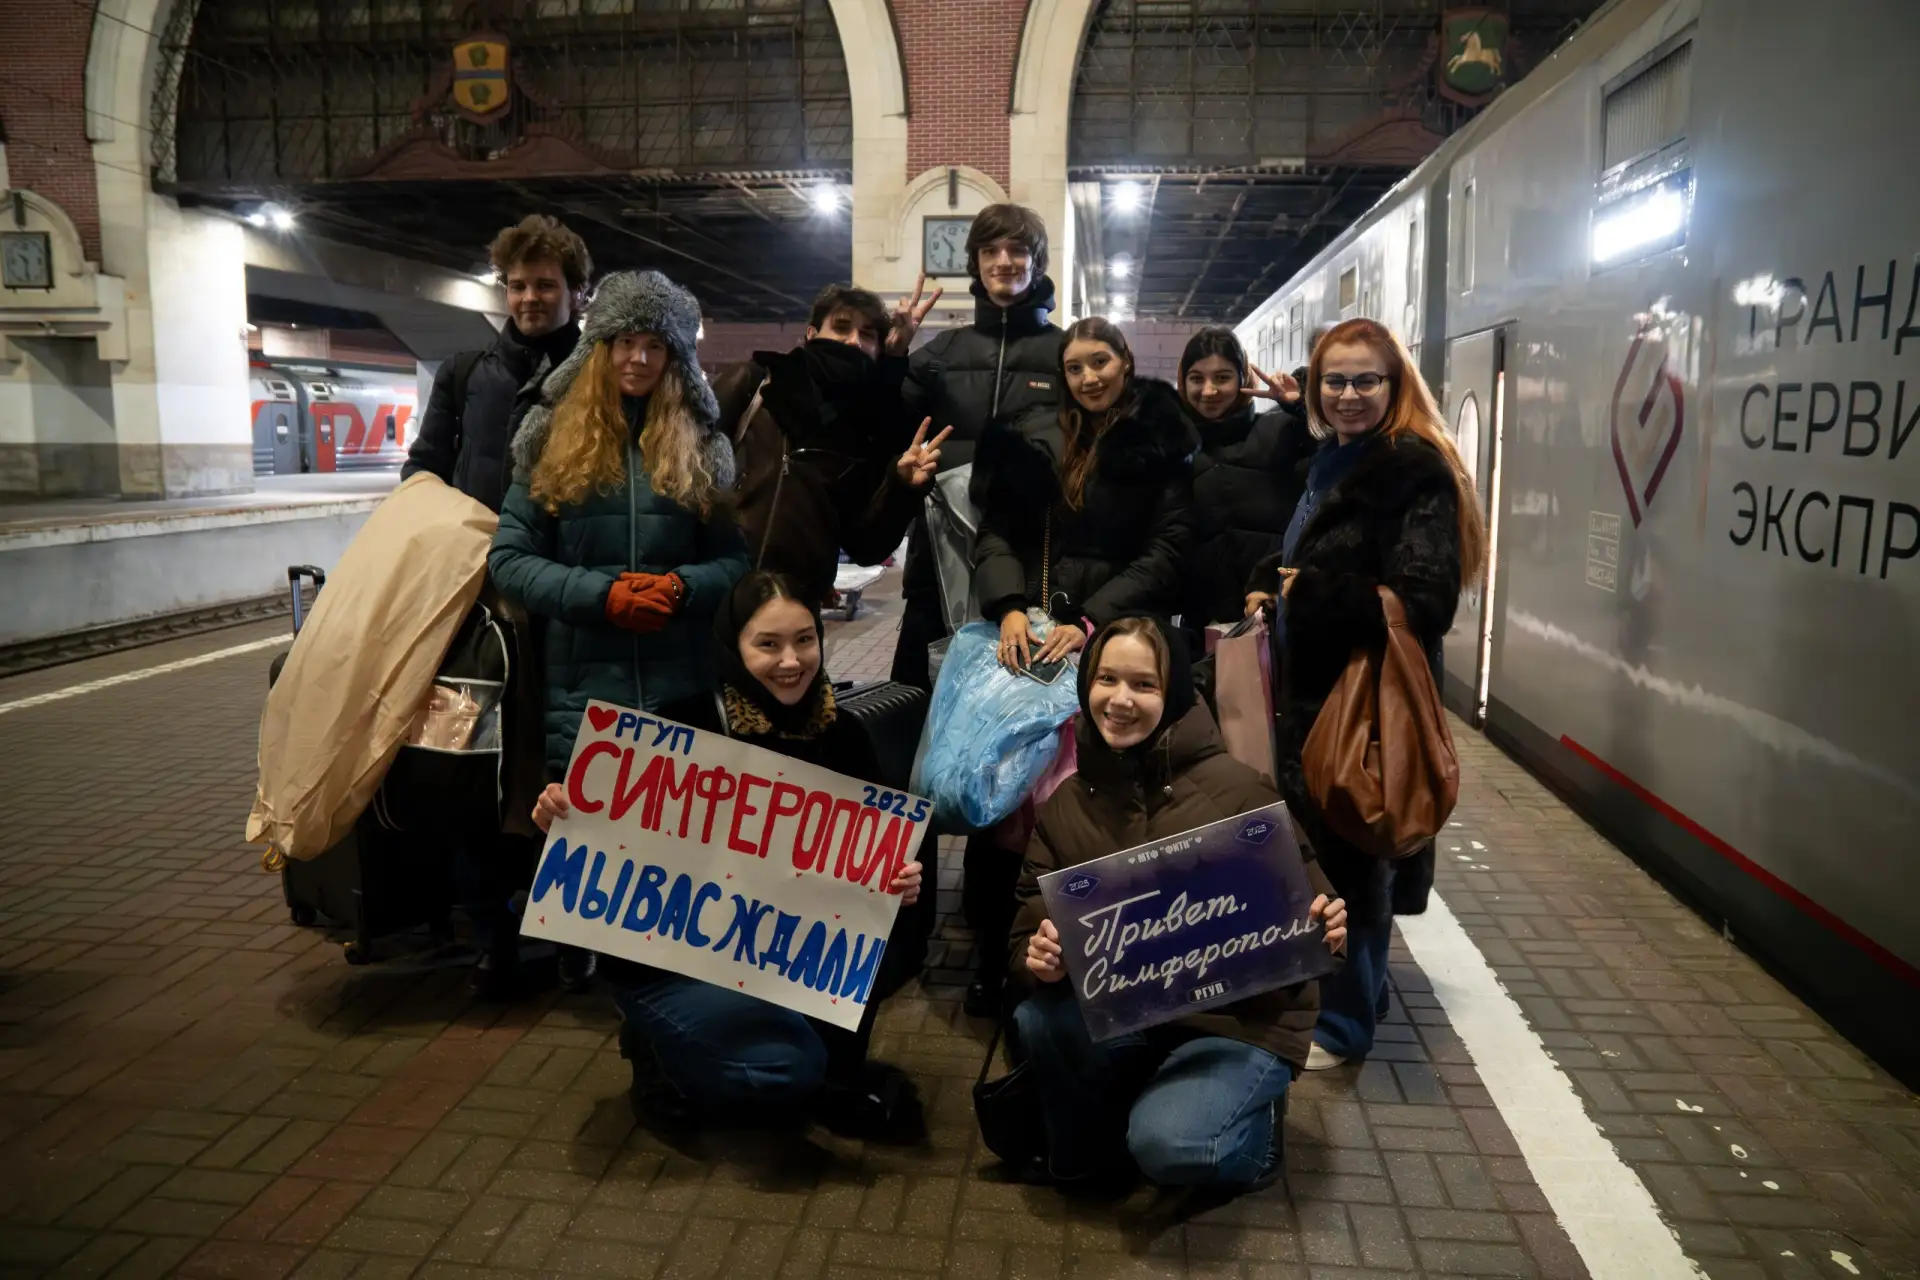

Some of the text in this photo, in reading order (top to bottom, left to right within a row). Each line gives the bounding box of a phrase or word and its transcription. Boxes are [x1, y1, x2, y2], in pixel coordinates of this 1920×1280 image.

[1729, 481, 1920, 580] ЭКСПР
[615, 712, 695, 755] РГУП
[568, 740, 915, 895] СИМФЕРОПОЛЬ
[863, 785, 931, 823] 2025
[1246, 824, 1267, 837] 2025
[532, 837, 634, 925] МЫ
[621, 865, 722, 948] ВАС
[1069, 879, 1090, 891] 2025
[1083, 915, 1320, 1000] Симферополь
[1194, 982, 1225, 1001] РГУП
